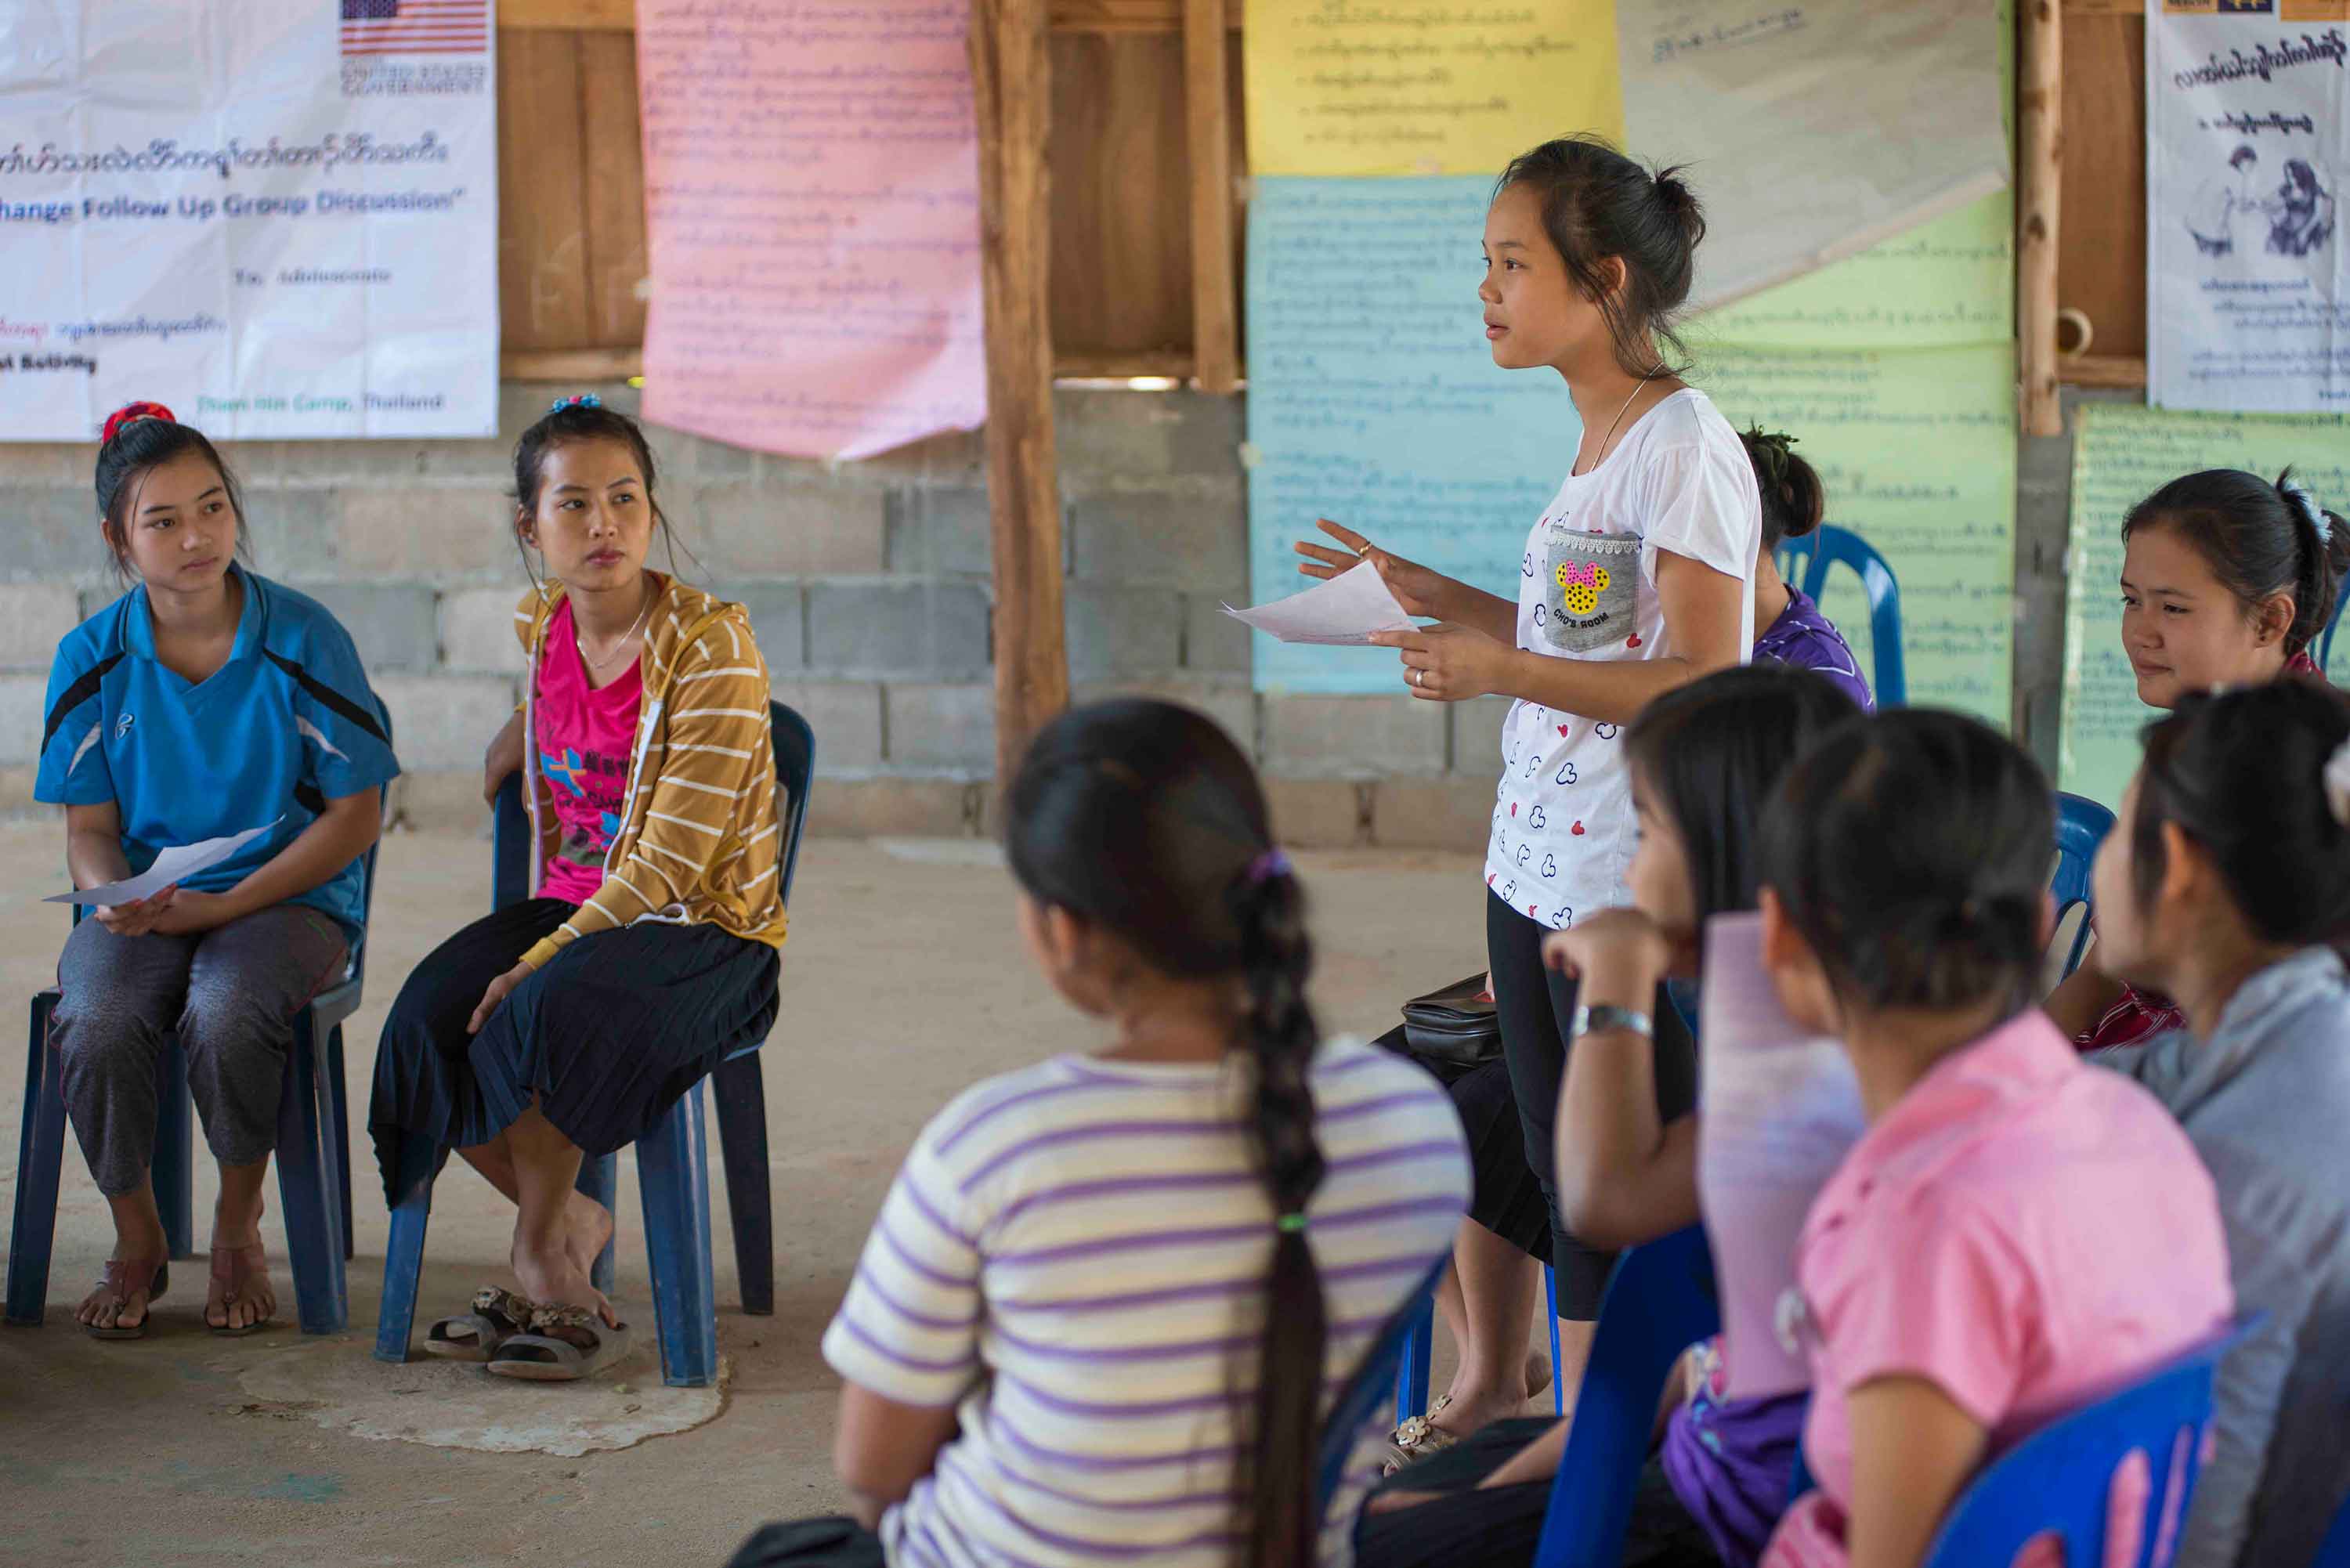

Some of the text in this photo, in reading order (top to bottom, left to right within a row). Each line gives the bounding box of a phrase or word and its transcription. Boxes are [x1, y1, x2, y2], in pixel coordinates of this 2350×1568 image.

[82, 196, 169, 217] Follow
[179, 197, 215, 219] Up
[222, 193, 309, 215] Group
[363, 392, 444, 410] Thailand
[1553, 609, 1577, 628] CHO'S
